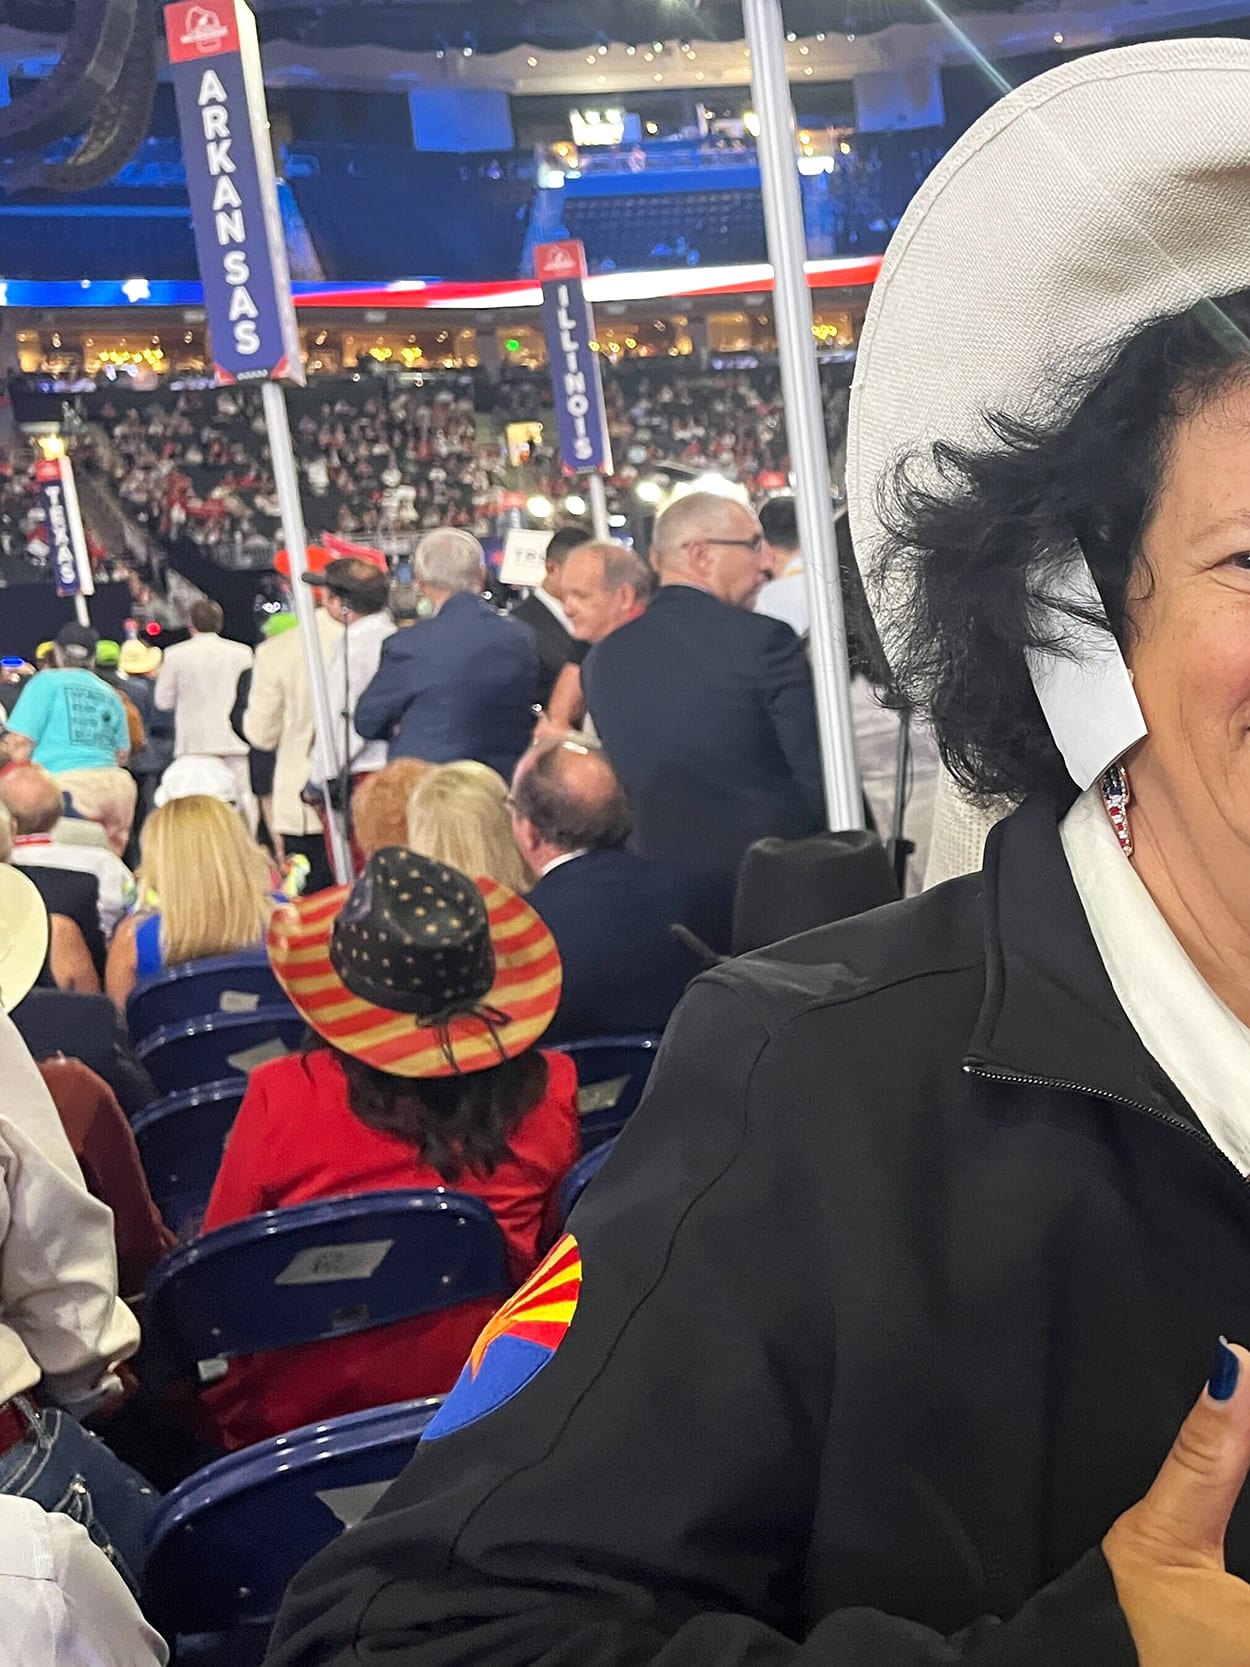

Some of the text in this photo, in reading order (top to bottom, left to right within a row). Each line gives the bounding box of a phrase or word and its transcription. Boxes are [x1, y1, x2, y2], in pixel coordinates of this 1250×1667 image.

[198, 69, 260, 355] ARKANSAS
[557, 284, 593, 460] ILLINOIS
[45, 485, 76, 584] TEXAS
